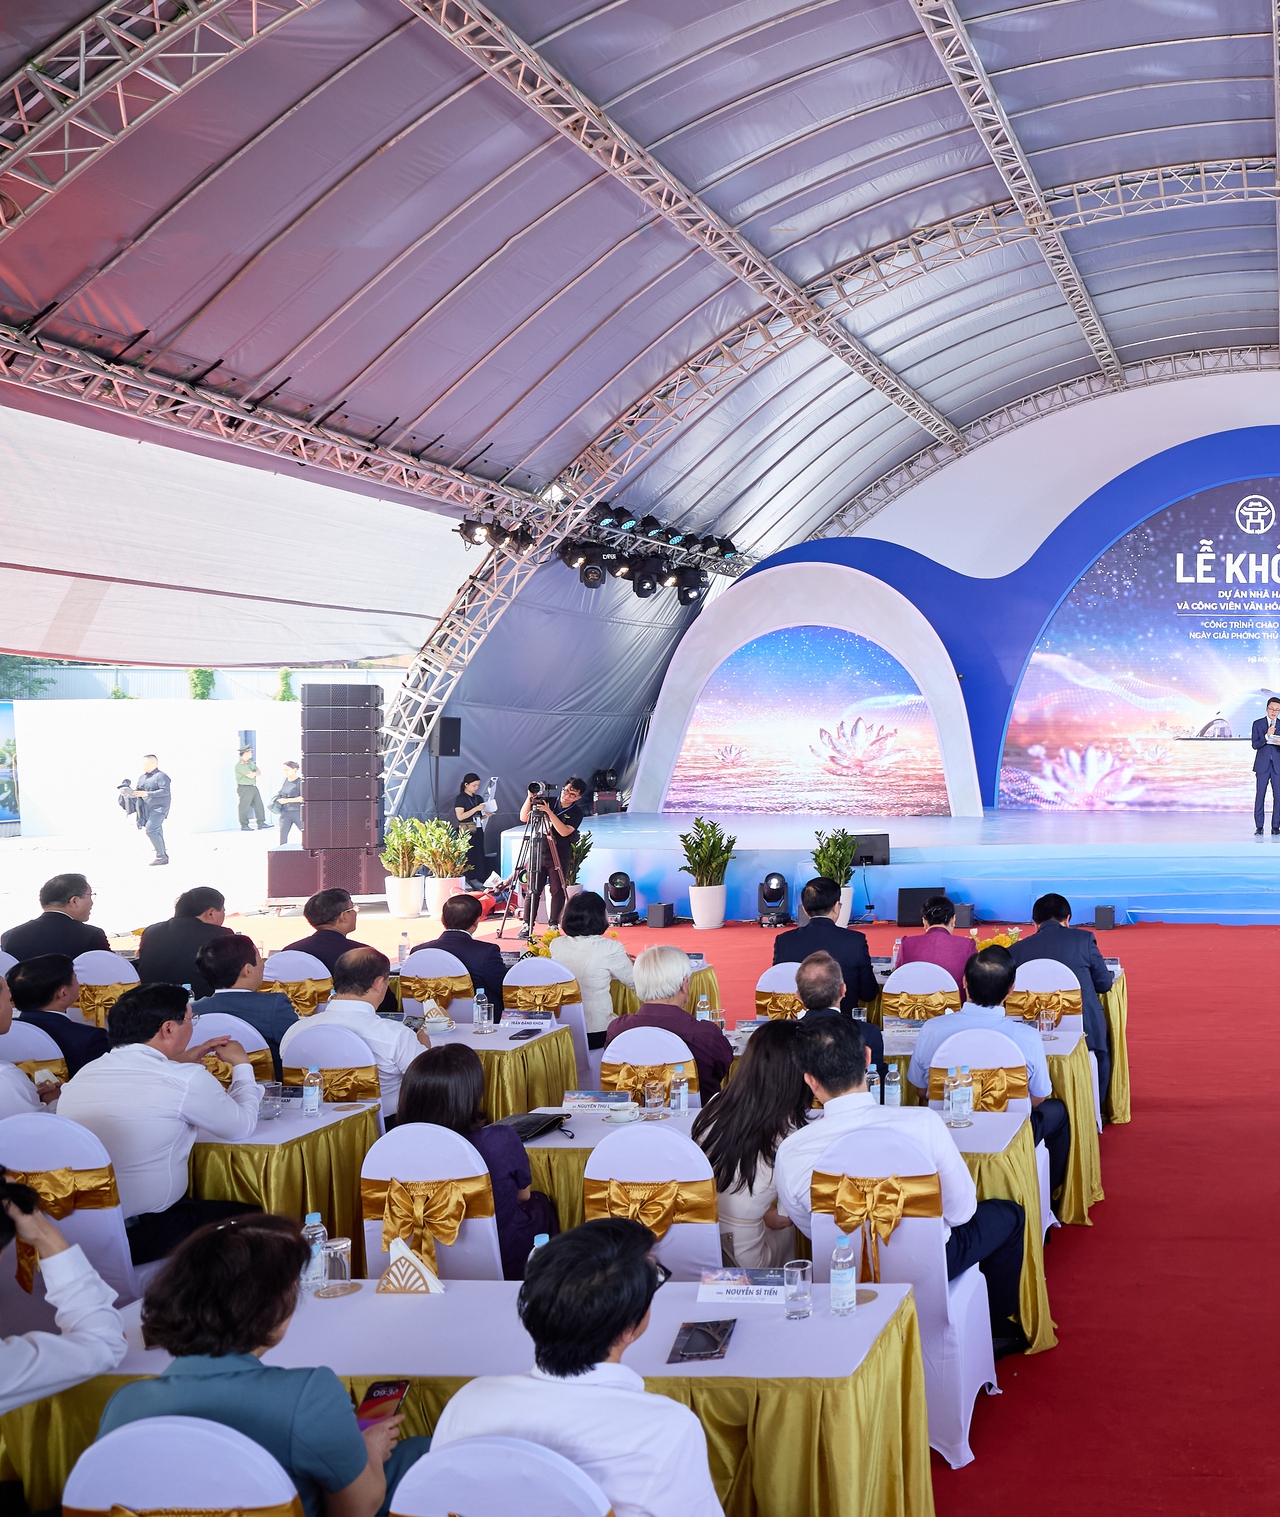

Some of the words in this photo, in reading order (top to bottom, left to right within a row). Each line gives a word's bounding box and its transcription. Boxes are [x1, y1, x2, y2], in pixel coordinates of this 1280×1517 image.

[1176, 539, 1216, 584] LỄ
[1218, 590, 1232, 600] DỰ
[1233, 589, 1248, 599] ÁN
[1249, 589, 1270, 599] NHÀ
[1176, 601, 1190, 610] VÀ
[1191, 601, 1218, 610] CÔNG
[1219, 601, 1242, 610] VIÊN
[1243, 601, 1263, 610] VĂN
[1229, 620, 1254, 629] TRÌNH
[1255, 621, 1280, 629] CHÀO
[1189, 631, 1212, 639] NGÀY
[1213, 631, 1229, 640] GIẢI
[1231, 631, 1261, 640] PHÓNG
[1262, 631, 1279, 640] THỦ
[725, 1286, 754, 1296] NGUYỄN
